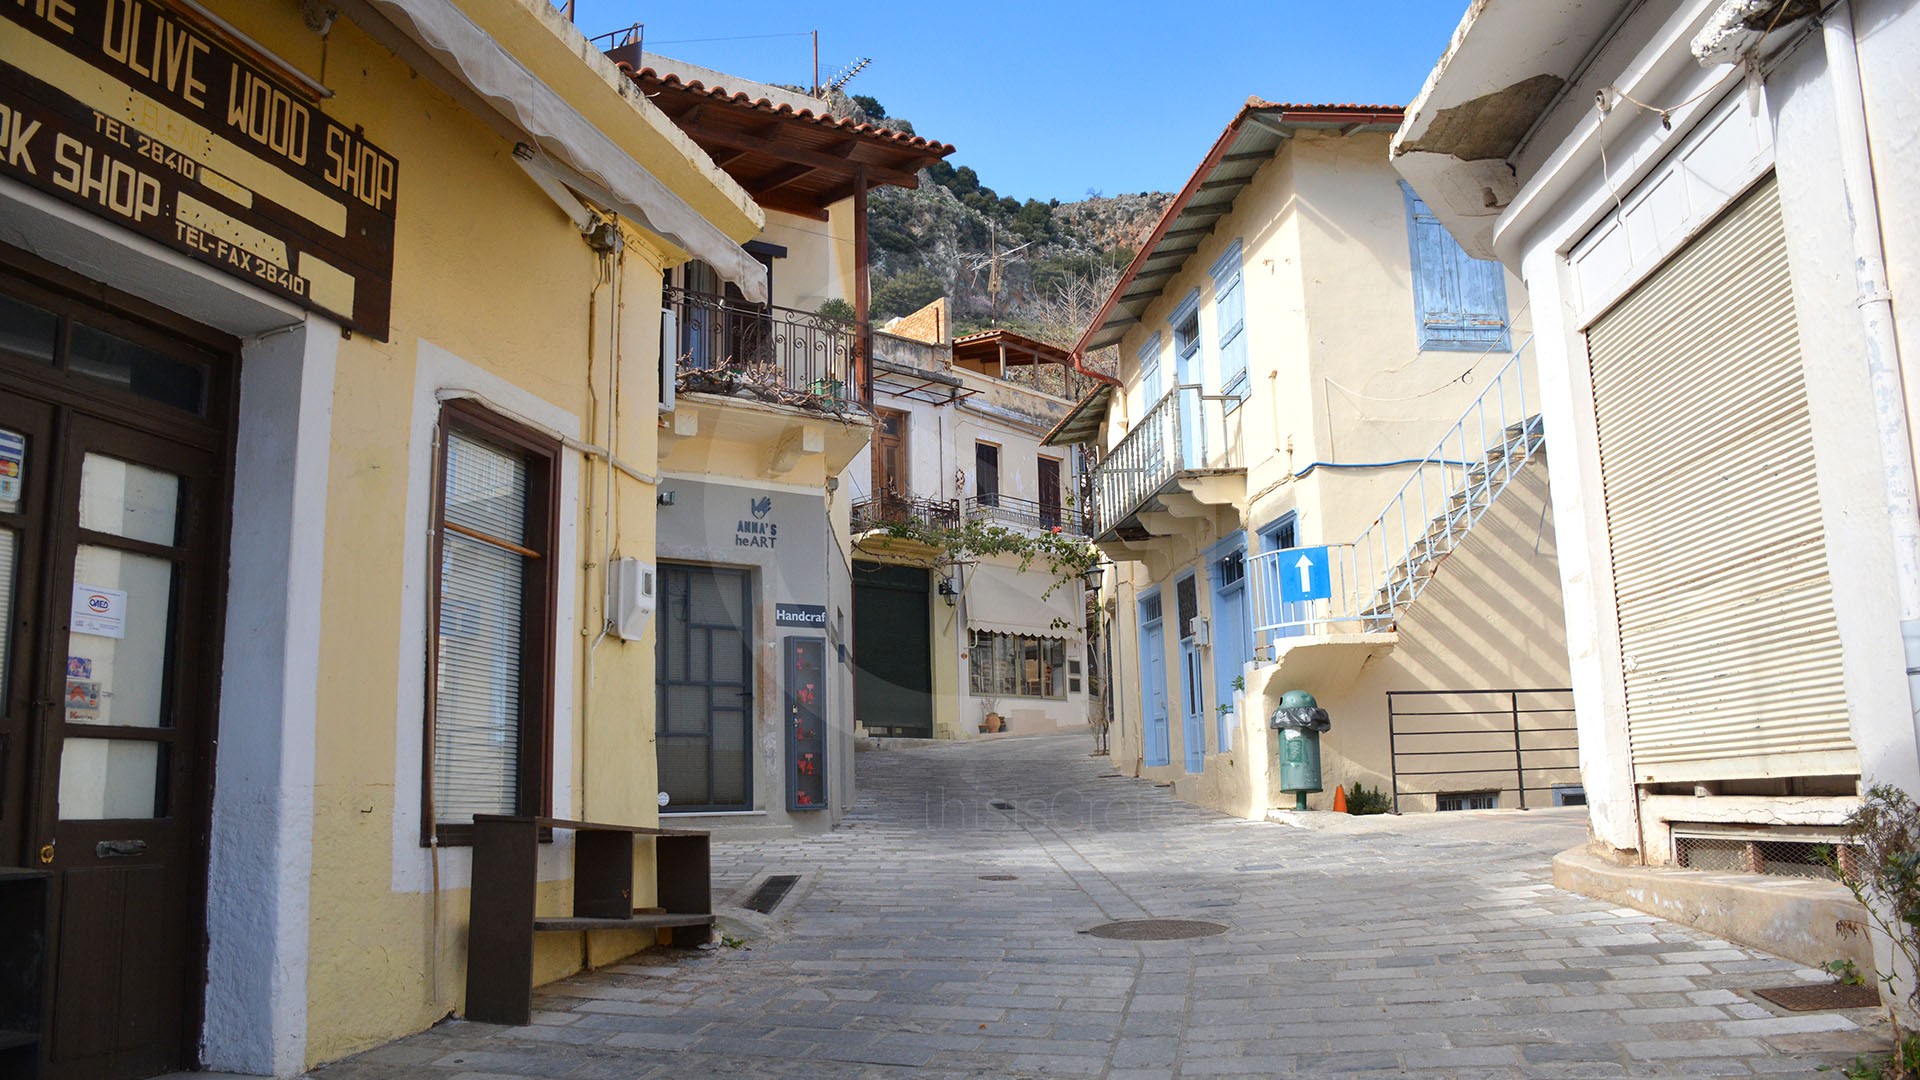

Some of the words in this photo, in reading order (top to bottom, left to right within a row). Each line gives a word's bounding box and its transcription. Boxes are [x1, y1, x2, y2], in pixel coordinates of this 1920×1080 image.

[103, 0, 210, 110] OLIVE
[227, 62, 310, 166] WOOD
[324, 124, 394, 210] SHOP
[52, 132, 161, 222] SHOP
[92, 110, 131, 148] TEL
[137, 136, 195, 180] 28410
[175, 220, 251, 273] TEL-FAX
[255, 258, 304, 295] 28410
[735, 534, 777, 549] heART
[737, 520, 777, 535] ANNA'S
[776, 609, 826, 623] Handcraf
